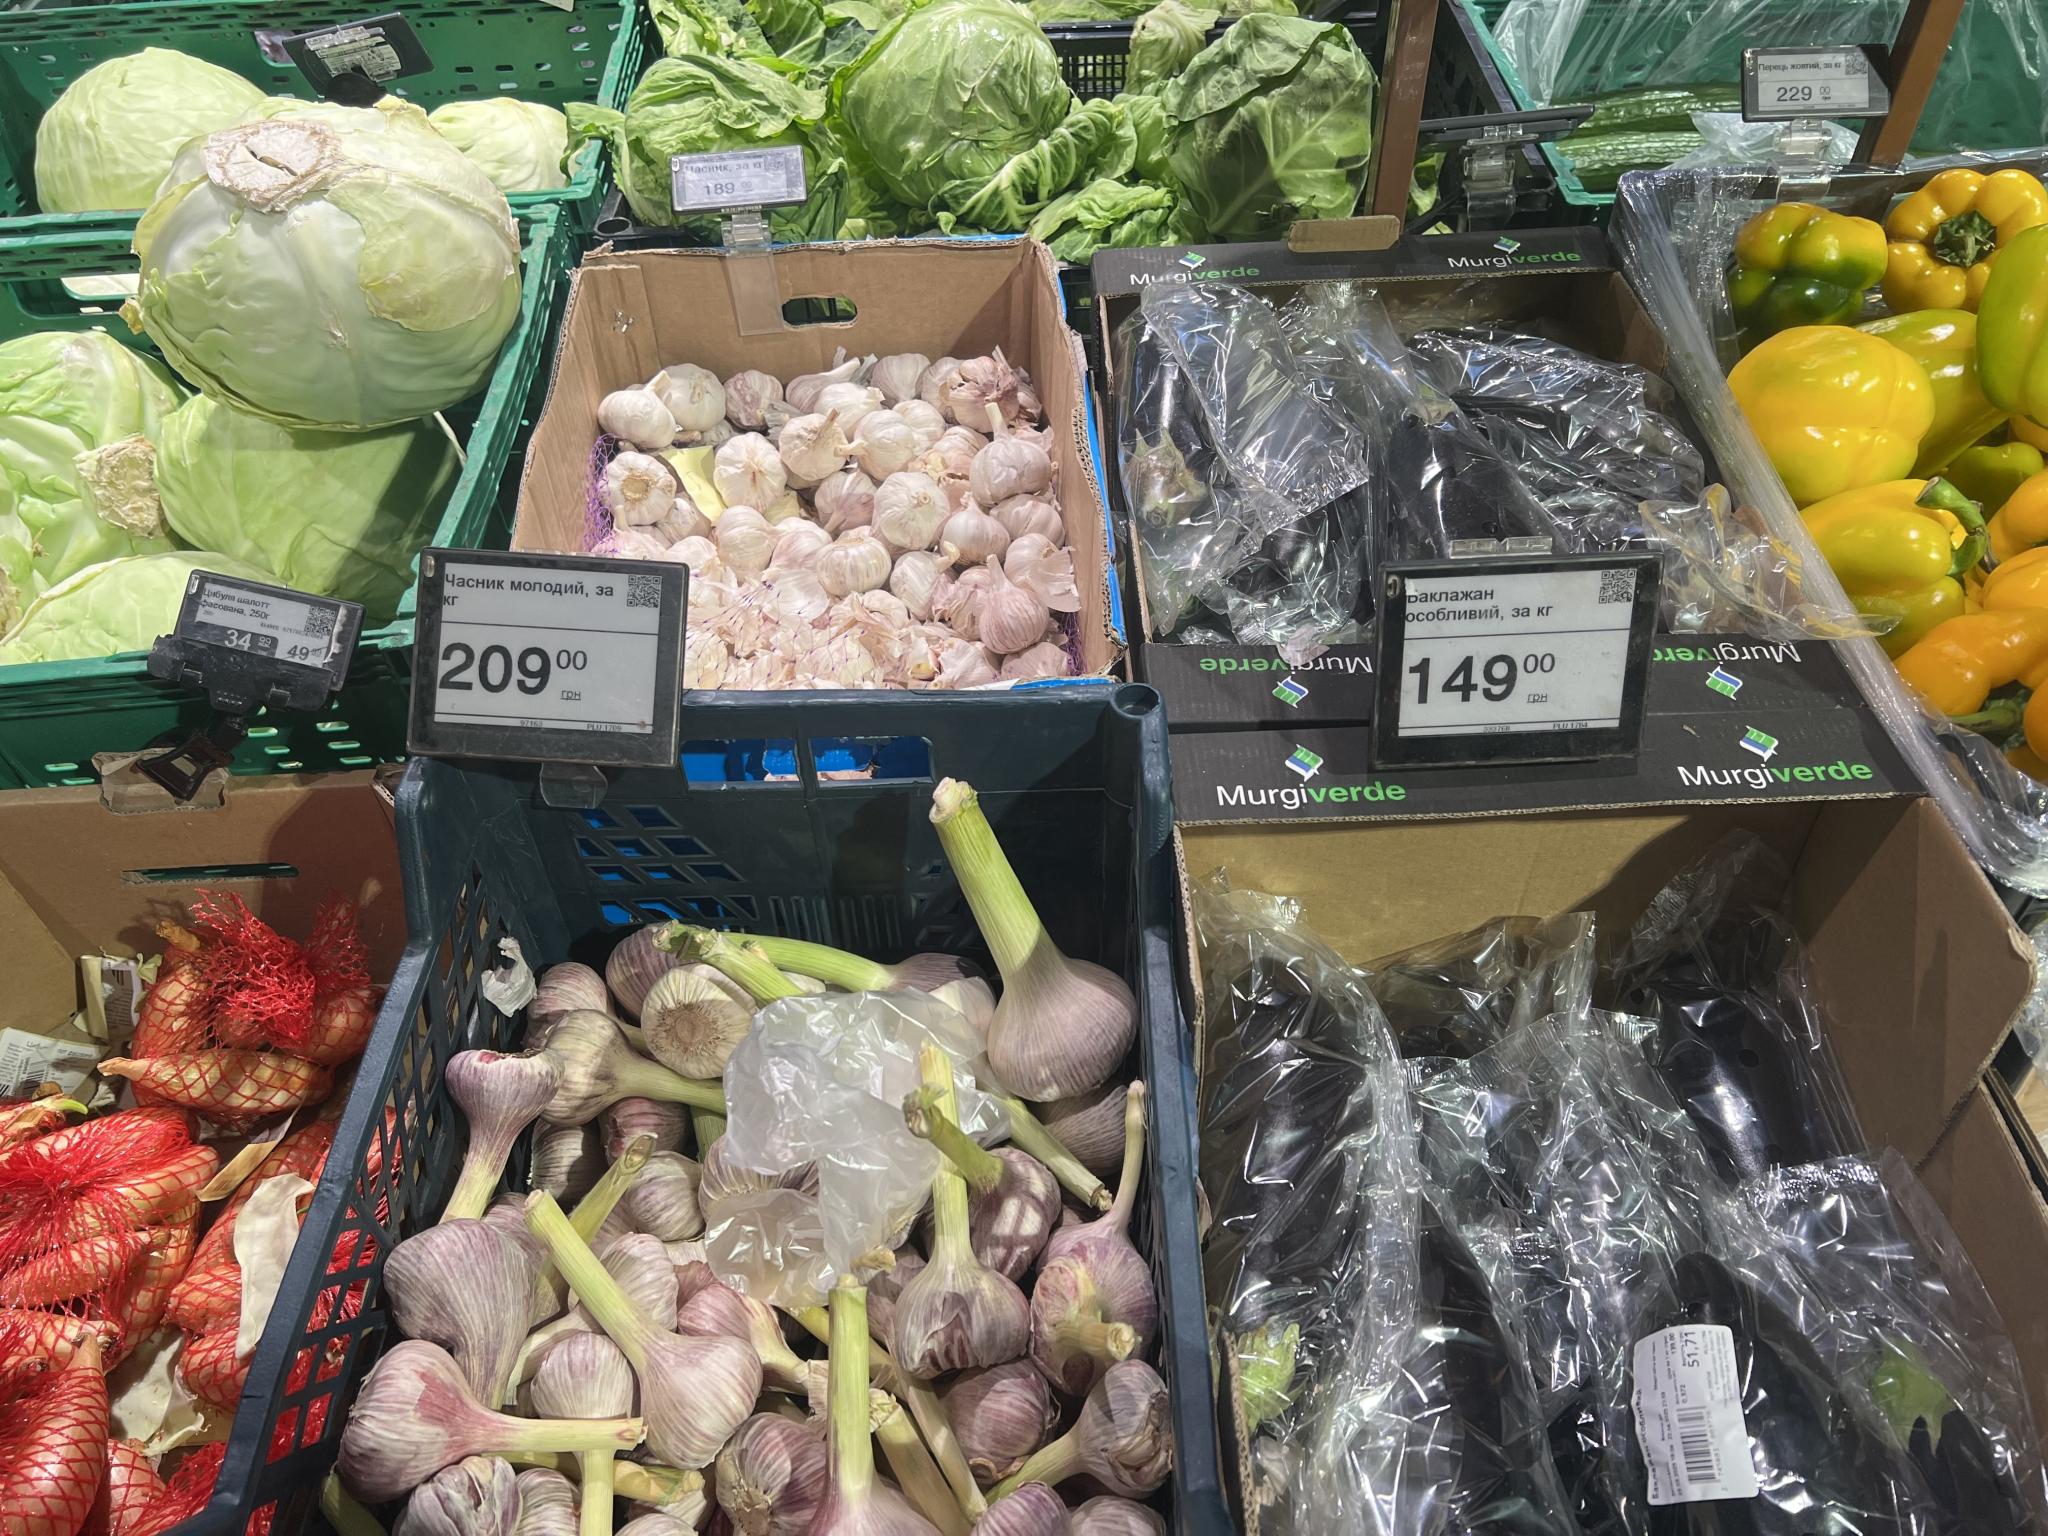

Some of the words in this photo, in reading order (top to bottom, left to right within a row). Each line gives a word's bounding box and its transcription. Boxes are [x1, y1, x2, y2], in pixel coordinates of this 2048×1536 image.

[1776, 86, 1812, 102] 229
[704, 182, 735, 196] 189
[1447, 251, 1581, 268] Murgiverde
[445, 573, 505, 590] Часник
[510, 581, 589, 598] молодий,
[596, 585, 614, 597] за
[237, 596, 272, 610] шалотт
[443, 595, 459, 606] кг
[1405, 606, 1504, 623] особливий,
[1511, 607, 1531, 618] за
[1537, 605, 1553, 617] кг
[224, 629, 252, 651] 34
[287, 645, 310, 661] 49
[439, 642, 551, 695] 209
[556, 649, 588, 670] 00
[1409, 653, 1518, 705] 149
[1523, 653, 1556, 674] 00
[560, 689, 581, 701] грн
[1526, 692, 1548, 703] грн
[1677, 761, 1873, 789] Murgiverde
[1216, 781, 1406, 810] Murgiverde
[1684, 1331, 1700, 1368] 51,71
